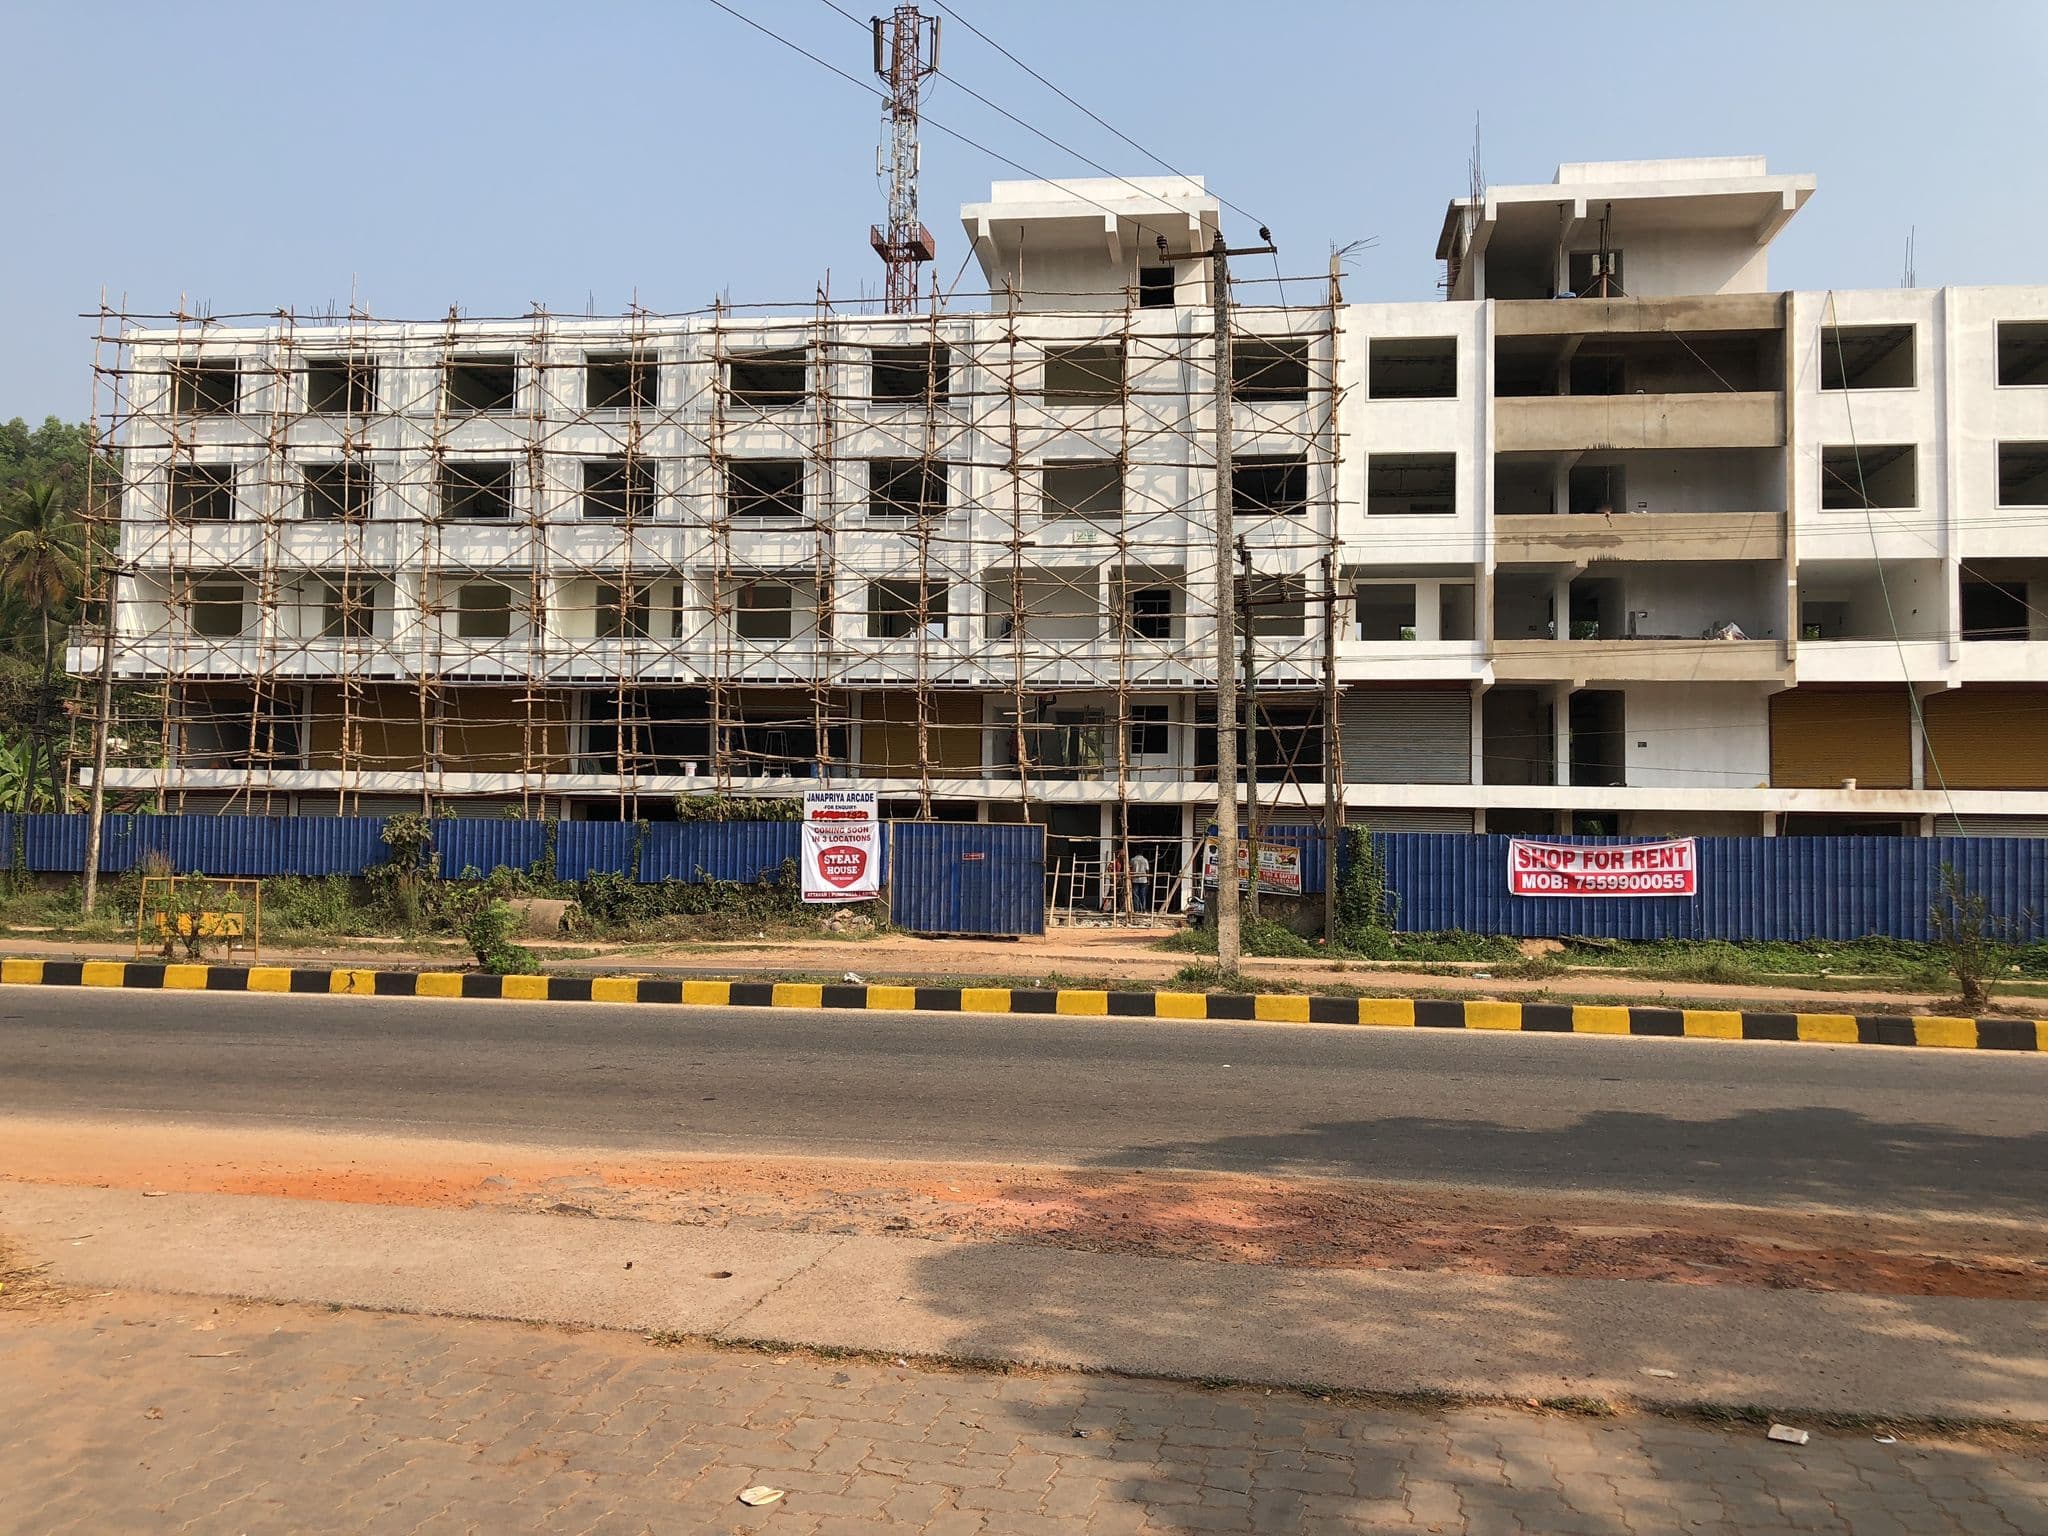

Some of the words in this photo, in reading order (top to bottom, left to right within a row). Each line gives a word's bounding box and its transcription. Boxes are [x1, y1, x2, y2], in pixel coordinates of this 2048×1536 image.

[807, 793, 844, 802] JANAPRIYA
[846, 793, 874, 802] ARCADE
[829, 834, 871, 842] LOCATIONS
[823, 854, 860, 864] STEAK
[1518, 848, 1575, 870] SHOP
[1583, 850, 1624, 870] FOR
[1632, 847, 1687, 869] RENT
[826, 866, 858, 875] HOUSE
[1521, 873, 1569, 889] MOB:
[1574, 873, 1685, 890] 7559900055
